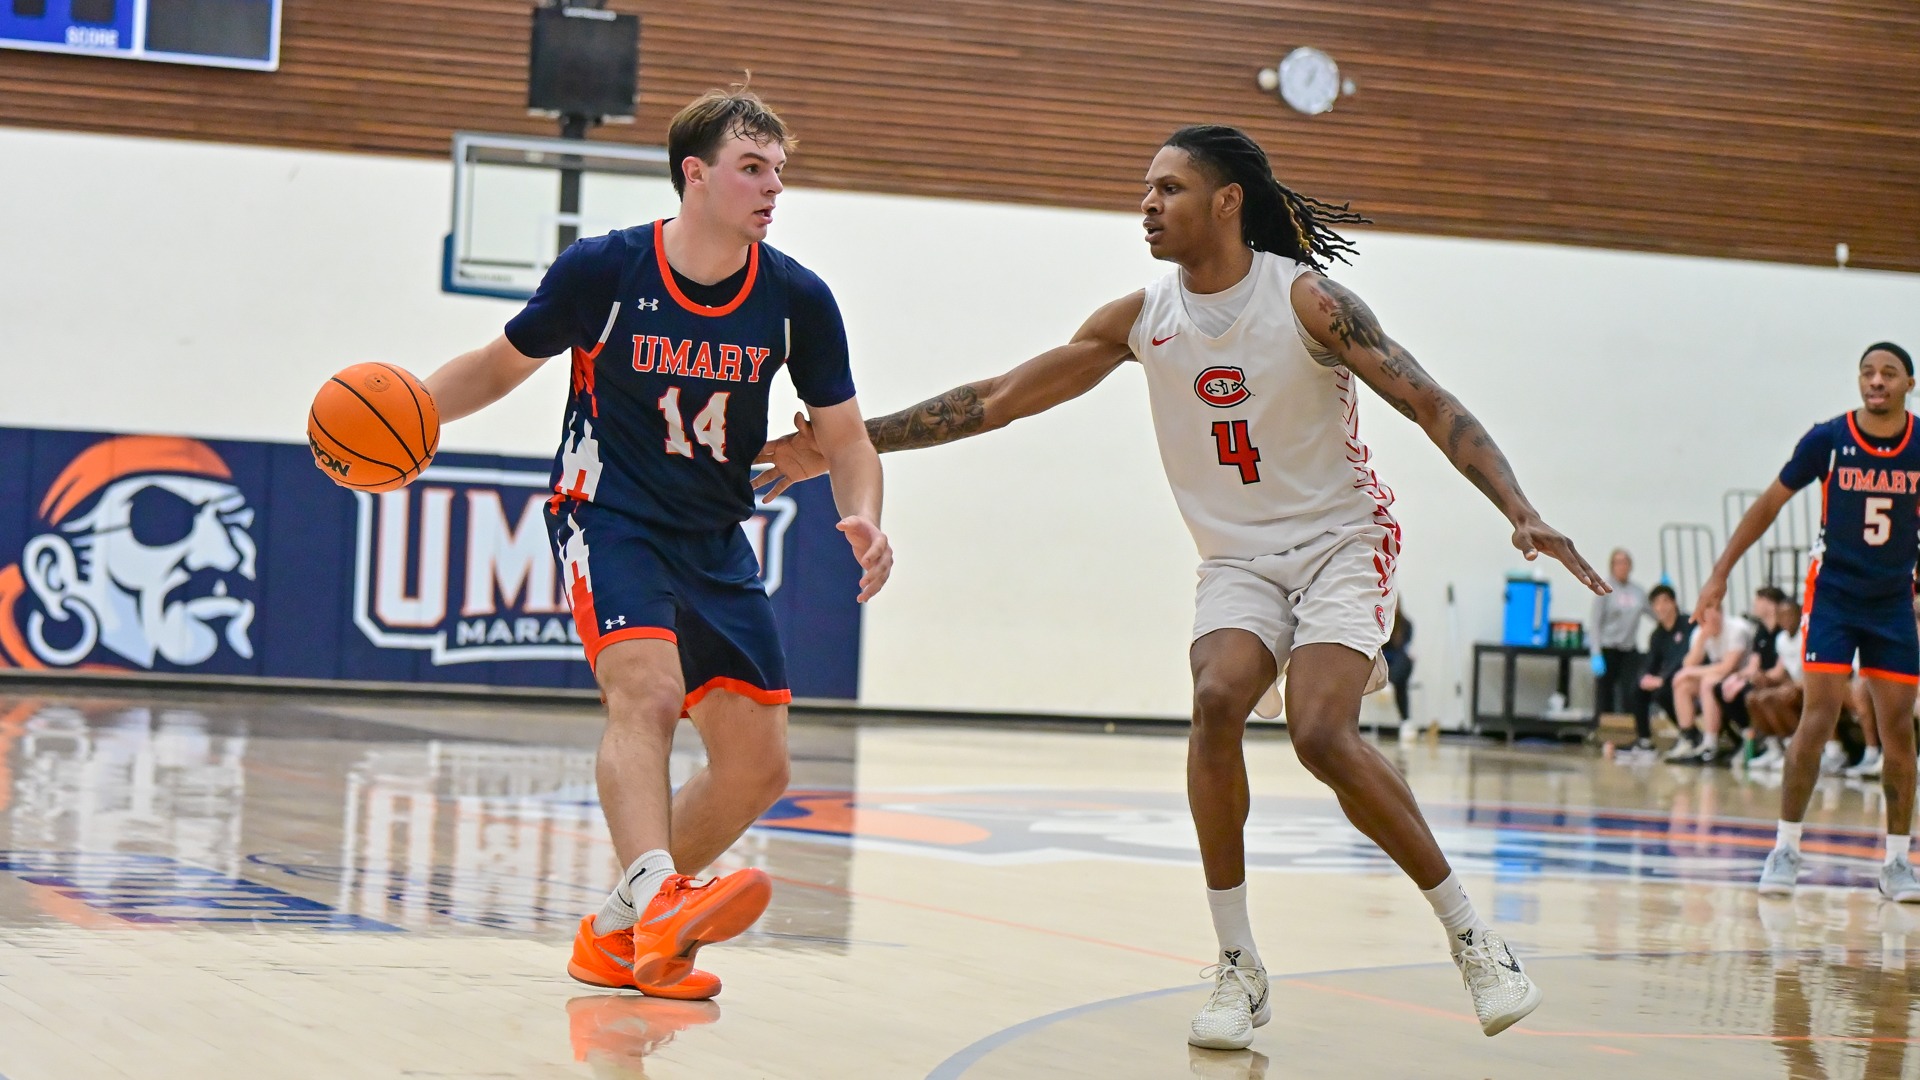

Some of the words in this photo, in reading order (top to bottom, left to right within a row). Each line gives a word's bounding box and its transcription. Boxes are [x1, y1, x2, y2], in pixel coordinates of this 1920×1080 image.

[632, 334, 770, 383] UMARY
[658, 386, 731, 463] 14
[1211, 420, 1261, 485] 4
[1838, 466, 1920, 494] UMARY
[1863, 497, 1893, 546] 5
